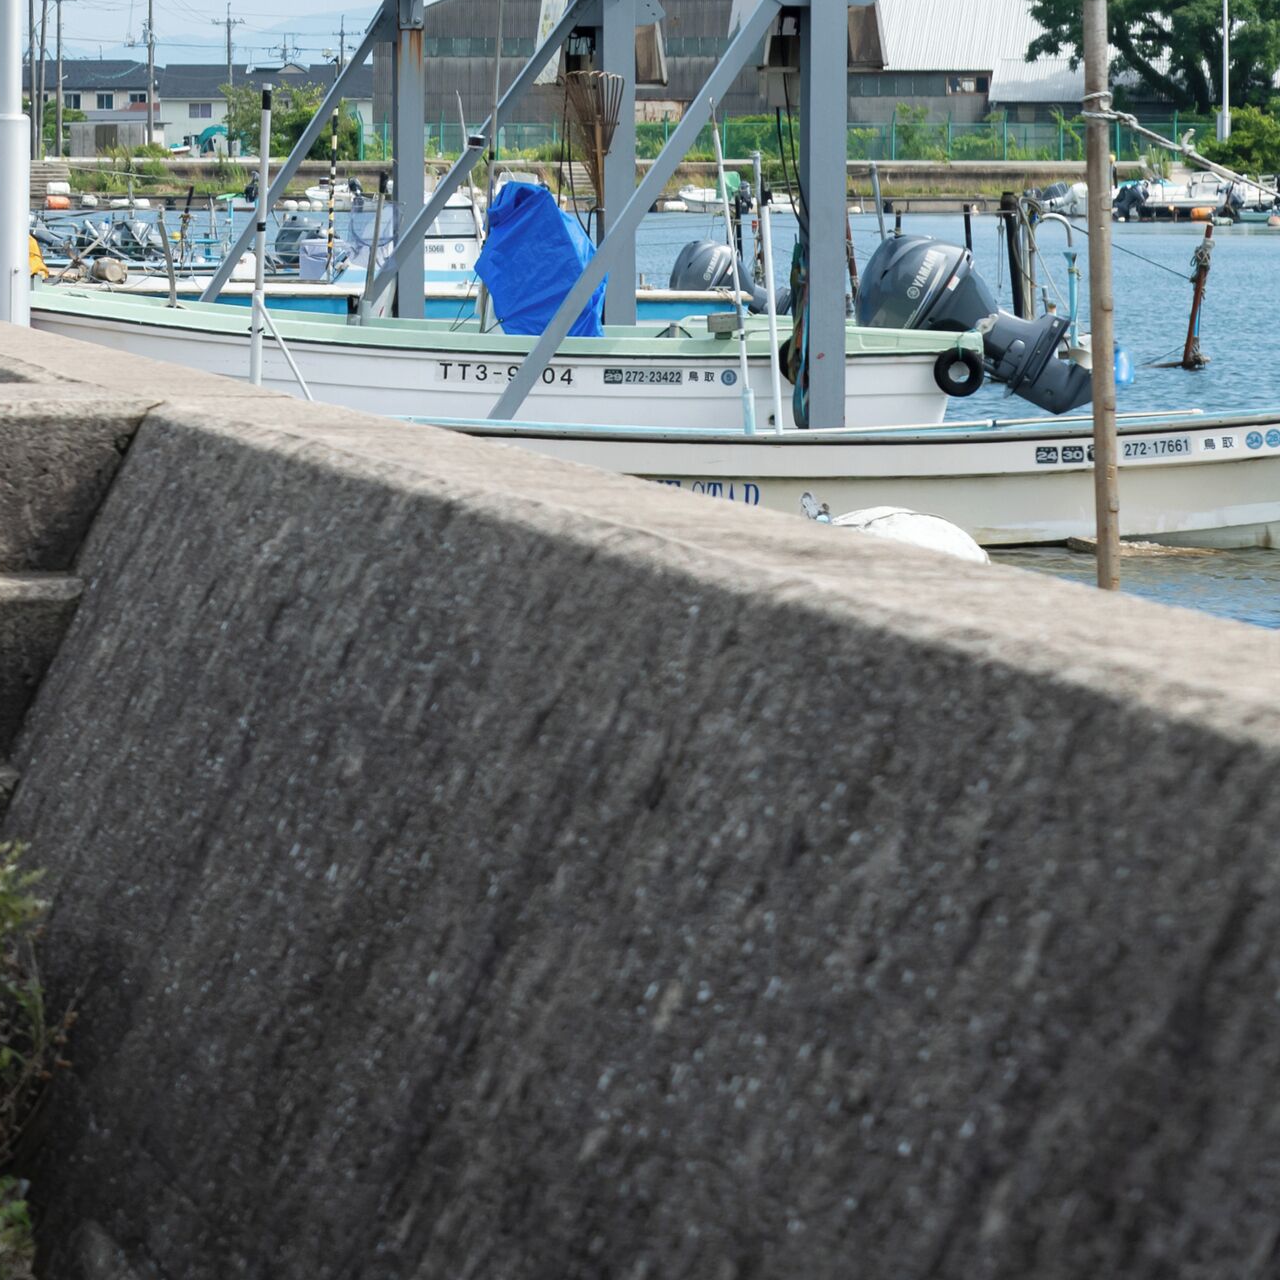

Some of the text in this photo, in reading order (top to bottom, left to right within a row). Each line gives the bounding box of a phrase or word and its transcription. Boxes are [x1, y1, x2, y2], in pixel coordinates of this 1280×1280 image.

[440, 362, 573, 385] TT3-904
[688, 371, 715, 382] 鳥取
[1037, 451, 1057, 461] 24
[1063, 450, 1083, 460] 30
[1204, 436, 1234, 450] 鳥取
